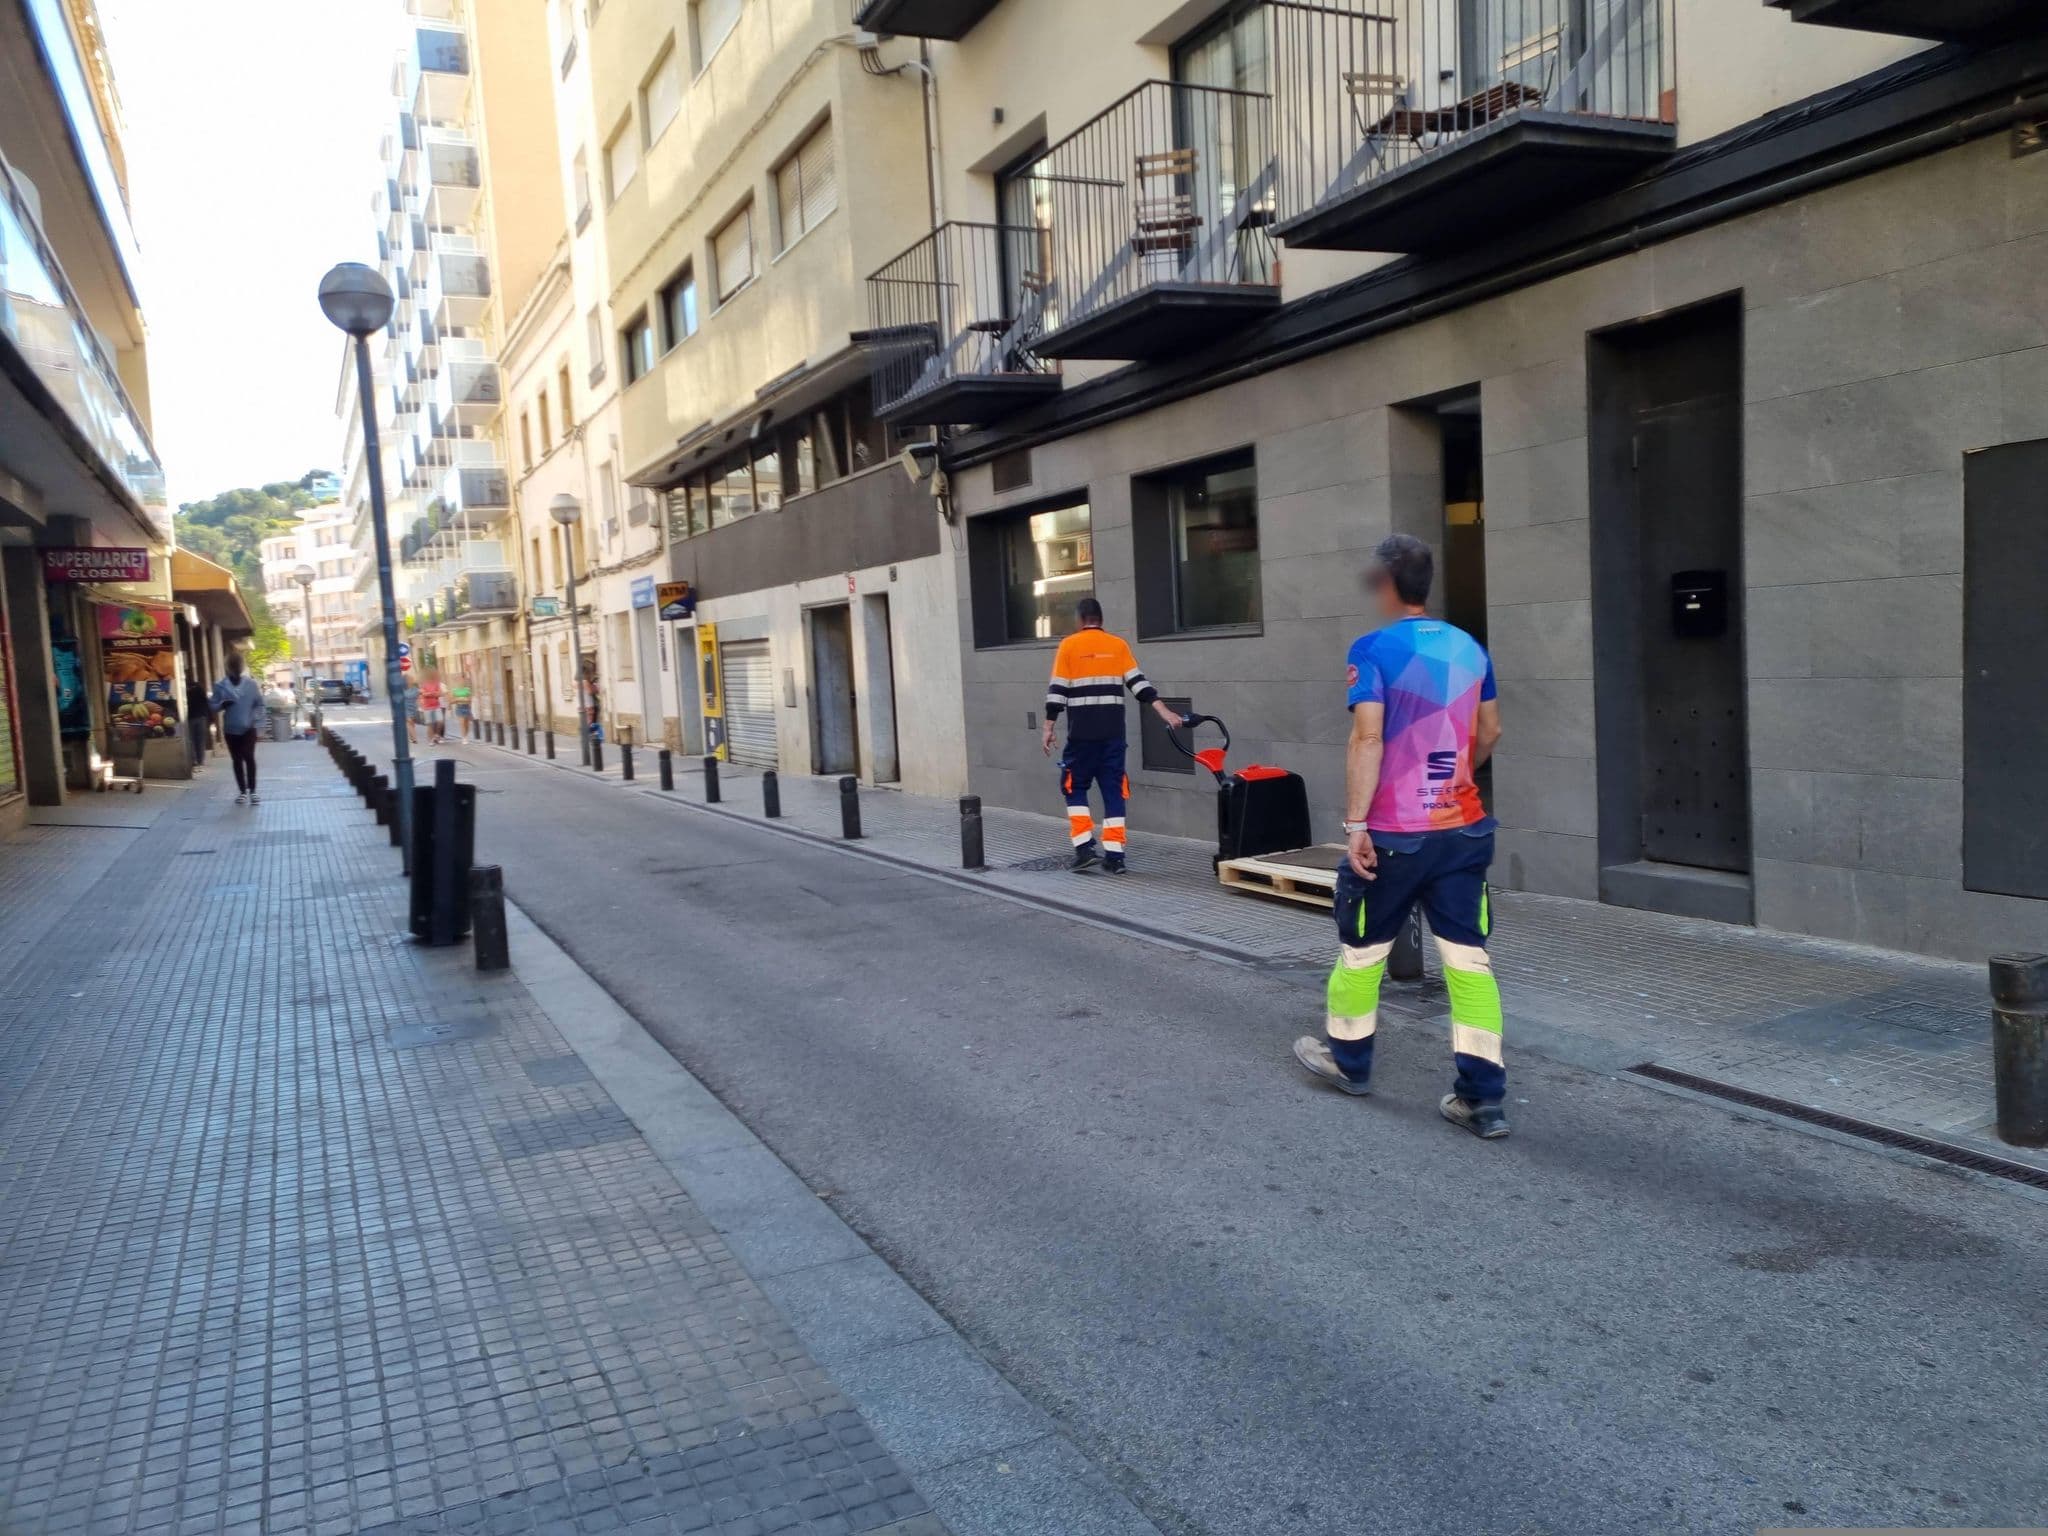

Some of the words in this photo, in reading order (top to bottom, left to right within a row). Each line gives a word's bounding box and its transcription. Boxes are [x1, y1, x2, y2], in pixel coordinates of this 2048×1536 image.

[47, 551, 146, 568] SUPERMARKET
[67, 569, 130, 578] GLOBAL
[660, 586, 687, 597] ATM
